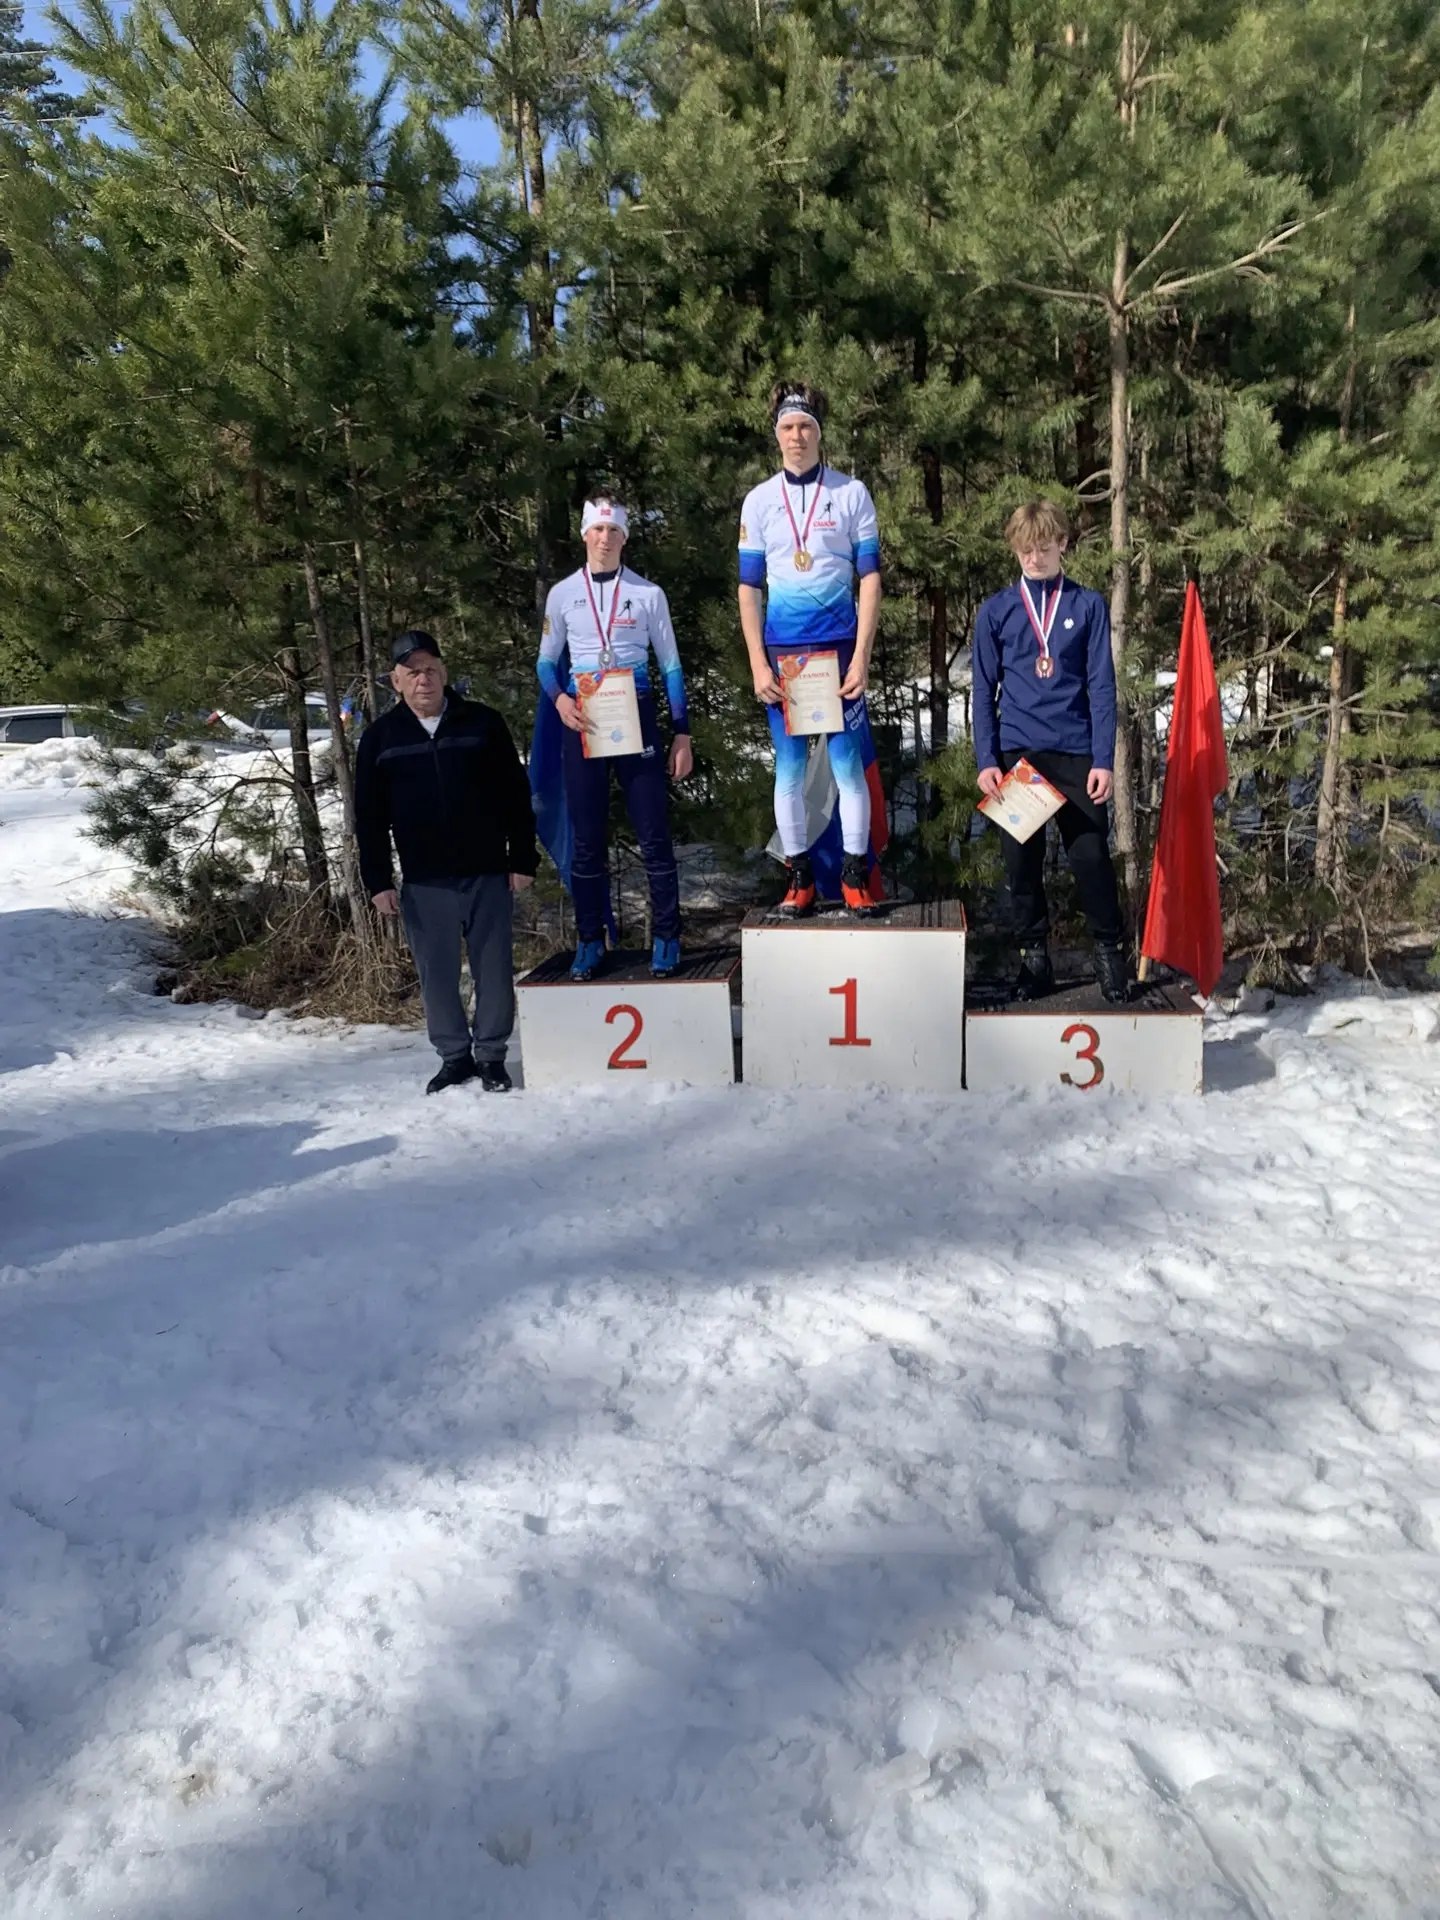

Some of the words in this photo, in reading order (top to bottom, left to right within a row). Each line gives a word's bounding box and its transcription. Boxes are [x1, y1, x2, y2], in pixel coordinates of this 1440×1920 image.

[604, 1004, 647, 1069] 2
[829, 978, 871, 1046] 1
[1060, 1024, 1104, 1089] 3
